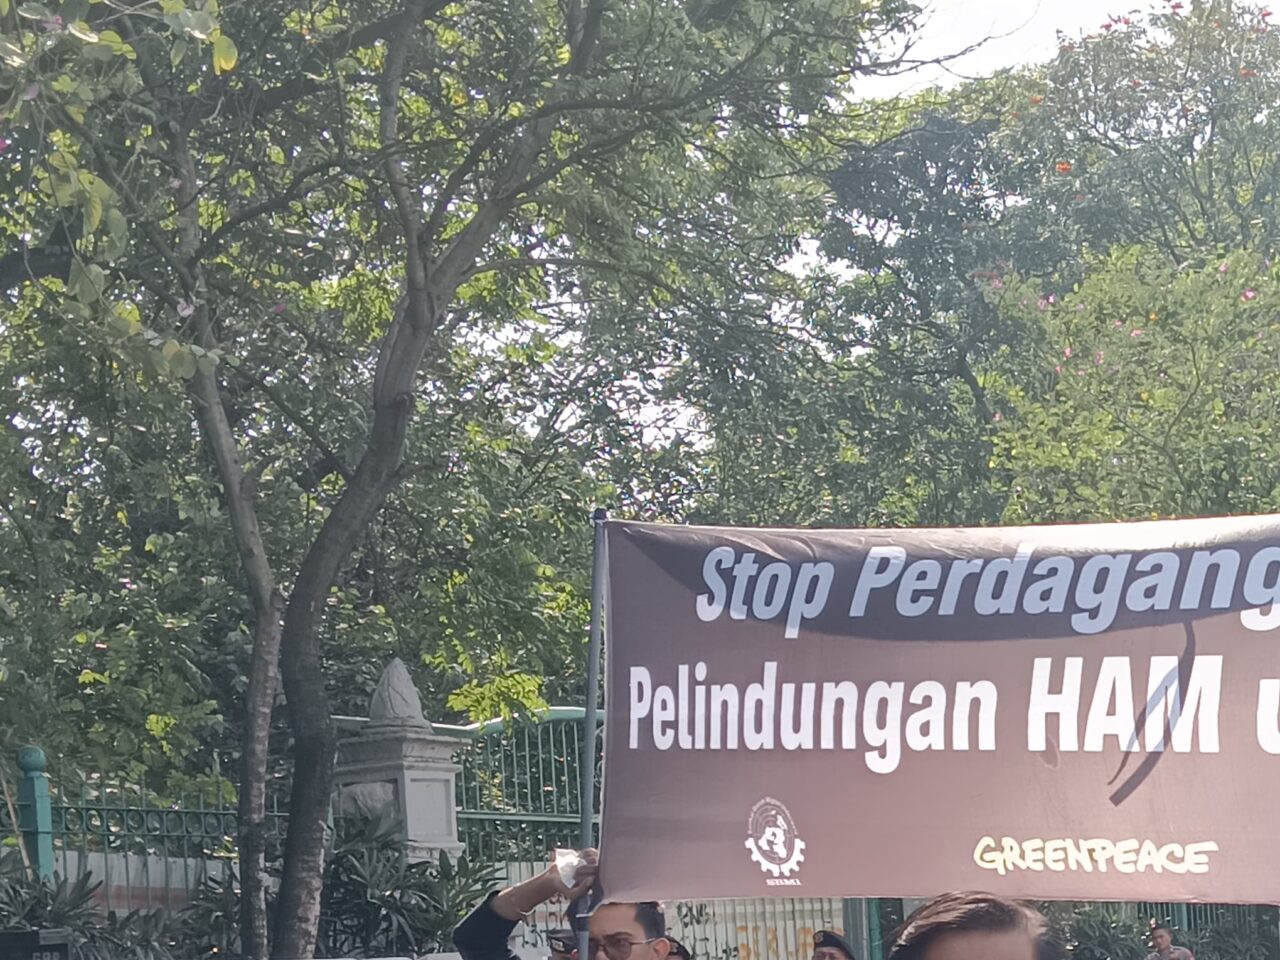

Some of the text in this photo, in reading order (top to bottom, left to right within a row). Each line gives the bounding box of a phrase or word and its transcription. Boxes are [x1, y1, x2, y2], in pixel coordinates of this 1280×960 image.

[696, 545, 835, 638] Stop
[629, 661, 996, 774] Pelindungan
[1027, 655, 1222, 753] HAM
[973, 836, 1219, 875] GREENPEACE
